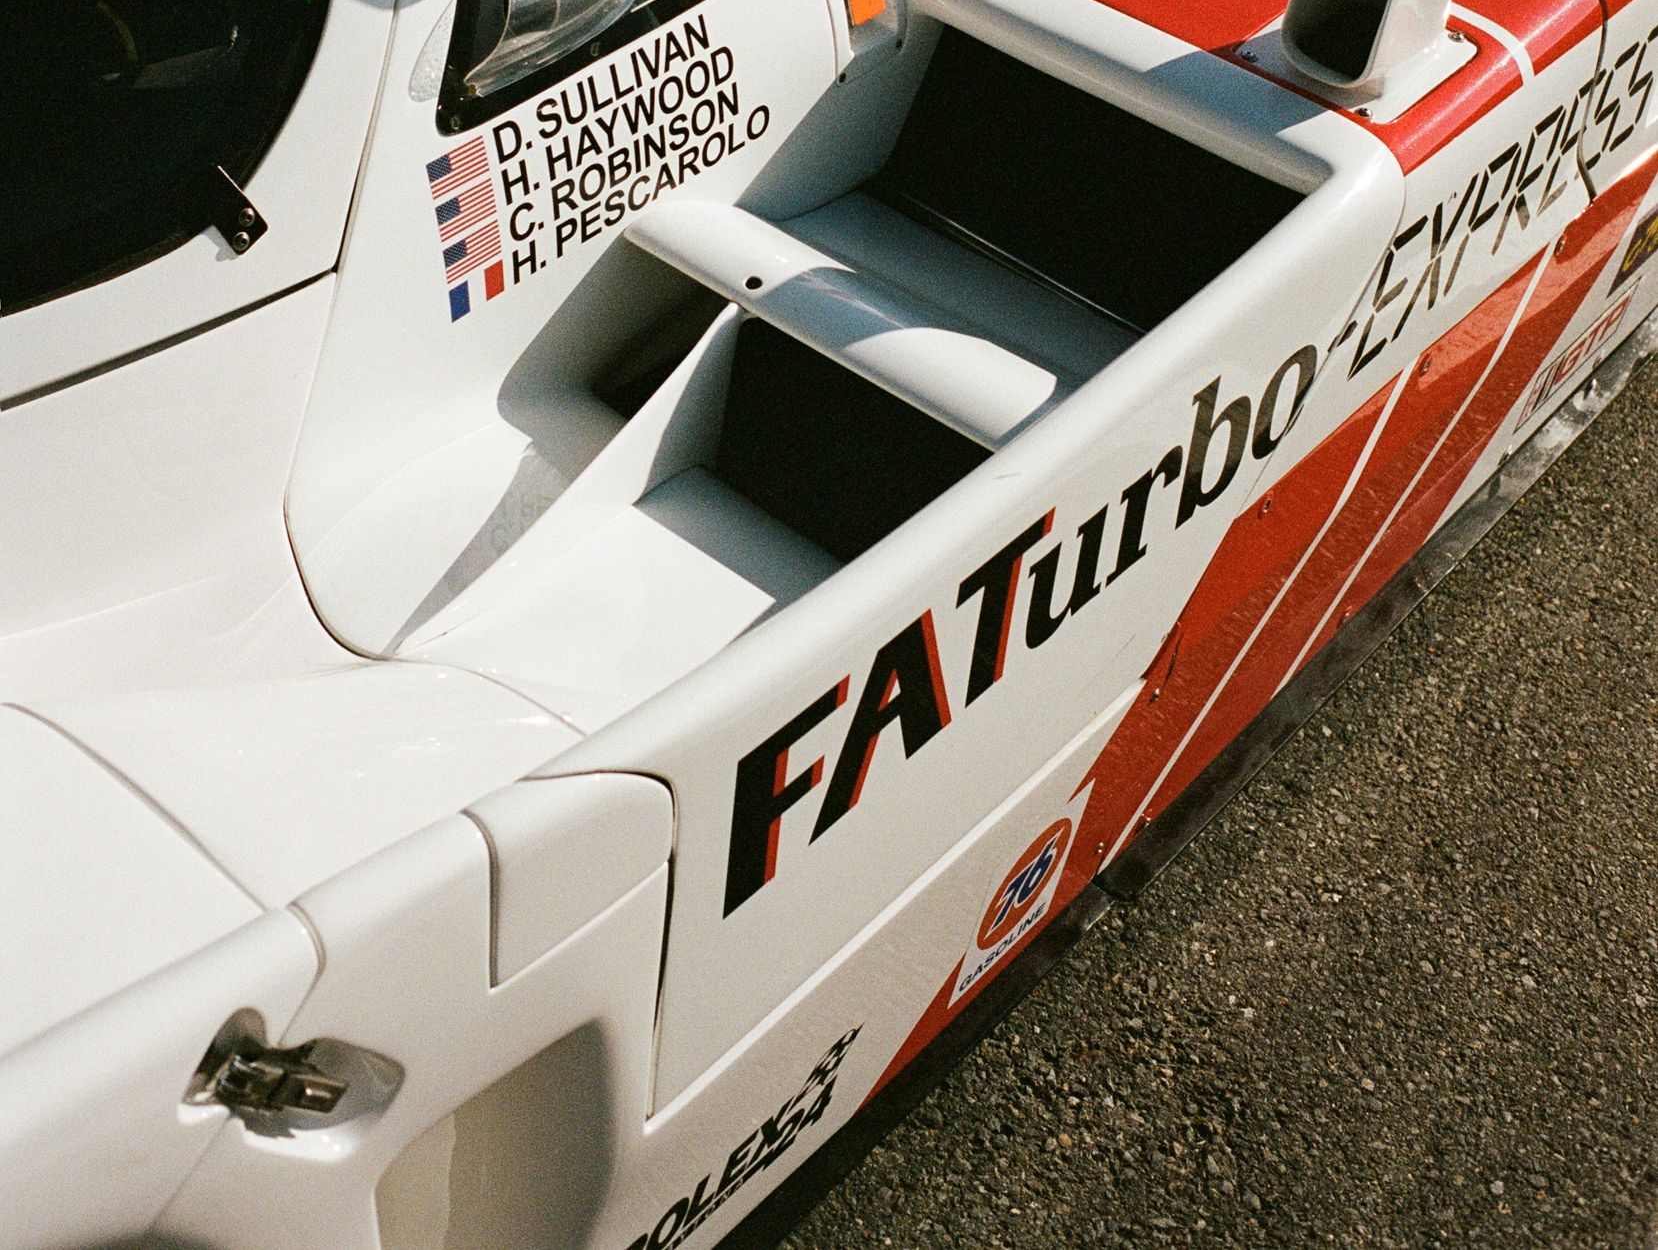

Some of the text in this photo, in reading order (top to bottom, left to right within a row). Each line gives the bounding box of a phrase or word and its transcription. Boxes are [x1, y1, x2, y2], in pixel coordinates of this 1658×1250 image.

[492, 14, 710, 164] D. SULLIVAN
[501, 46, 734, 205] H. HAYWOOD
[509, 82, 739, 242] C. ROBINSON
[511, 105, 770, 285] H. PESCAROLO
[959, 902, 1046, 992] GASOLINE
[991, 836, 1054, 931] 76
